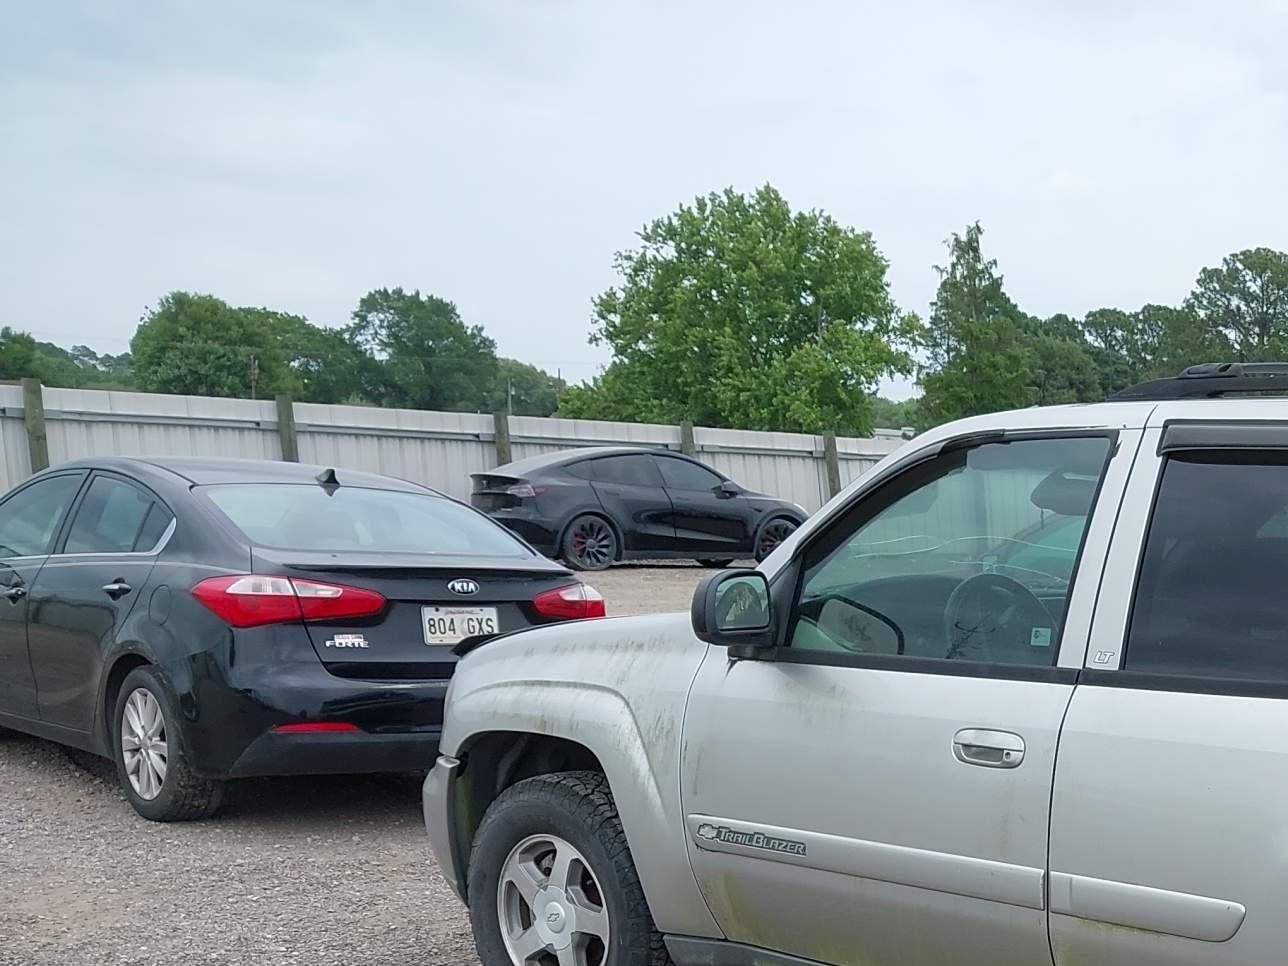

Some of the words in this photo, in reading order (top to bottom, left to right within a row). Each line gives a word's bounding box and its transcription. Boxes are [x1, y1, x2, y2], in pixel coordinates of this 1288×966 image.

[454, 580, 476, 593] KIA
[427, 617, 457, 635] 804
[466, 617, 494, 635] GXS
[1093, 650, 1116, 664] LT
